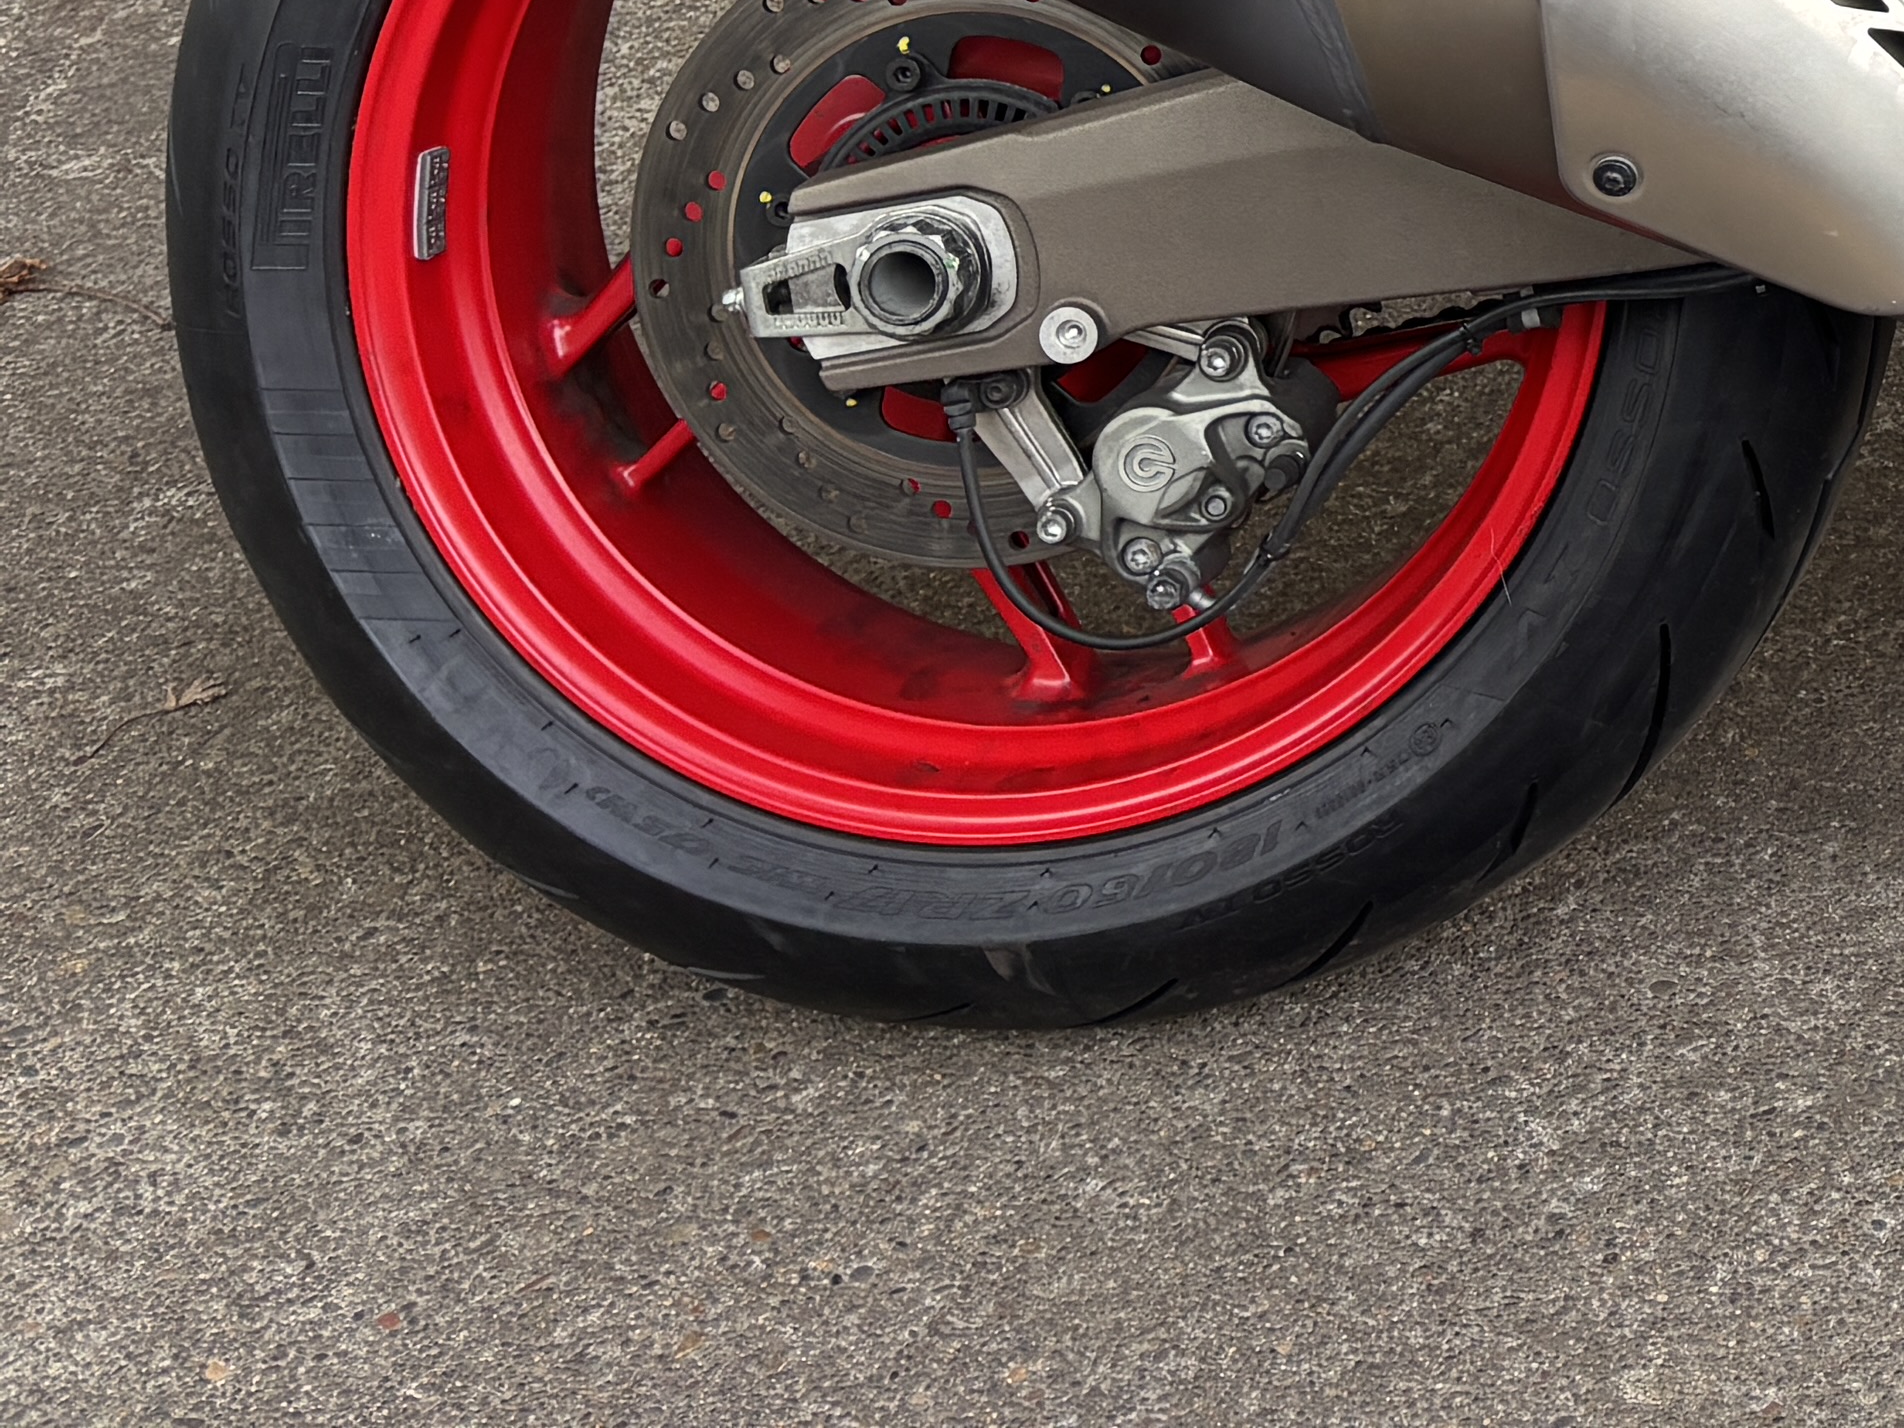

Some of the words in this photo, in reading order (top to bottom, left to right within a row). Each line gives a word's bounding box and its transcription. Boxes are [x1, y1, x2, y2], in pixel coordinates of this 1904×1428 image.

[250, 40, 334, 270] PIRELLI
[1582, 310, 1667, 529] OSSO
[1250, 811, 1406, 905] ROSSO
